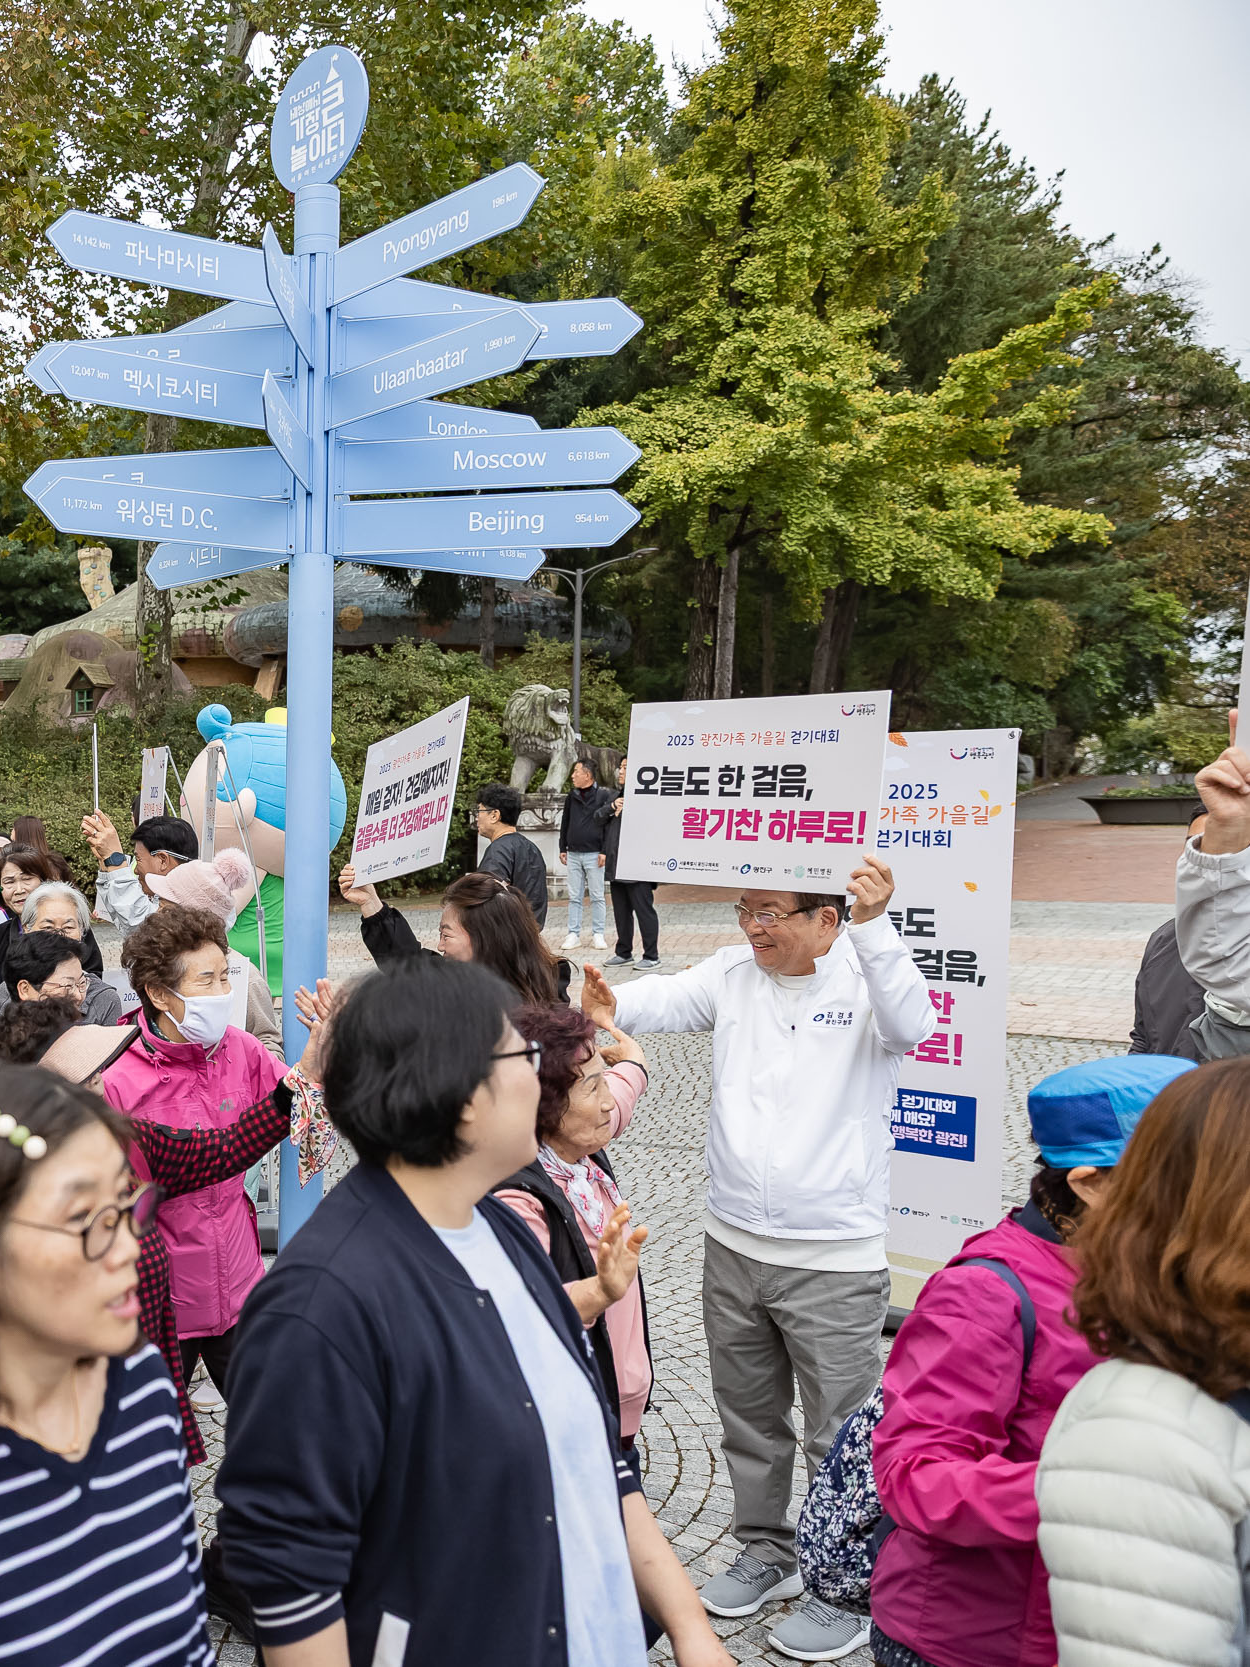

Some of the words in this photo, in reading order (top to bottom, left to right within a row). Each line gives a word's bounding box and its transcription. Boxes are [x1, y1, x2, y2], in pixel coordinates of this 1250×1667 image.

[322, 80, 344, 127] 큰
[290, 107, 320, 142] 가장
[291, 118, 345, 173] 놀이터
[383, 208, 469, 264] Pyongyang
[505, 192, 518, 203] km
[72, 233, 97, 248] 14,142
[98, 238, 111, 250] km
[125, 241, 219, 280] 파나마시티
[570, 322, 594, 334] 8,058
[597, 322, 612, 331] km
[373, 346, 469, 395] Ulaanbaatar
[503, 334, 516, 345] km
[70, 364, 96, 378] 12,047
[97, 368, 110, 380] km
[123, 369, 218, 407] 멕시코시티
[453, 450, 547, 471] Moscow
[568, 451, 594, 462] 6,618
[595, 451, 610, 460] km
[62, 497, 88, 511] 11,172
[90, 500, 103, 511] km
[116, 499, 174, 528] 워싱턴
[182, 507, 218, 531] D.C.
[469, 510, 545, 534] Beijing
[575, 513, 592, 524] 954
[594, 513, 609, 523] km
[188, 547, 221, 568] 시드니
[667, 735, 695, 746] 2025
[700, 732, 746, 747] 광진가족
[751, 730, 786, 746] 가을길
[790, 729, 840, 745] 걷기대회
[379, 762, 391, 775] 2025
[634, 766, 710, 797] 오늘도
[717, 765, 745, 797] 한
[751, 764, 813, 802] 걸음,
[365, 788, 384, 816] 매일
[405, 757, 452, 802] 건강해지자!
[888, 783, 938, 800] 2025
[356, 818, 389, 852] 걸을수록
[388, 815, 400, 840] 더
[398, 794, 448, 839] 건강해집니다
[682, 807, 763, 842] 활기찬
[768, 810, 867, 844] 하루로!
[928, 804, 990, 825] 가을길
[877, 829, 952, 848] 걷기대회
[912, 948, 986, 987] 걸음,
[902, 1094, 957, 1114] 걷기대회
[903, 1111, 936, 1127] 해요!
[891, 1124, 934, 1144] 행복한
[935, 1130, 968, 1148] 광진!
